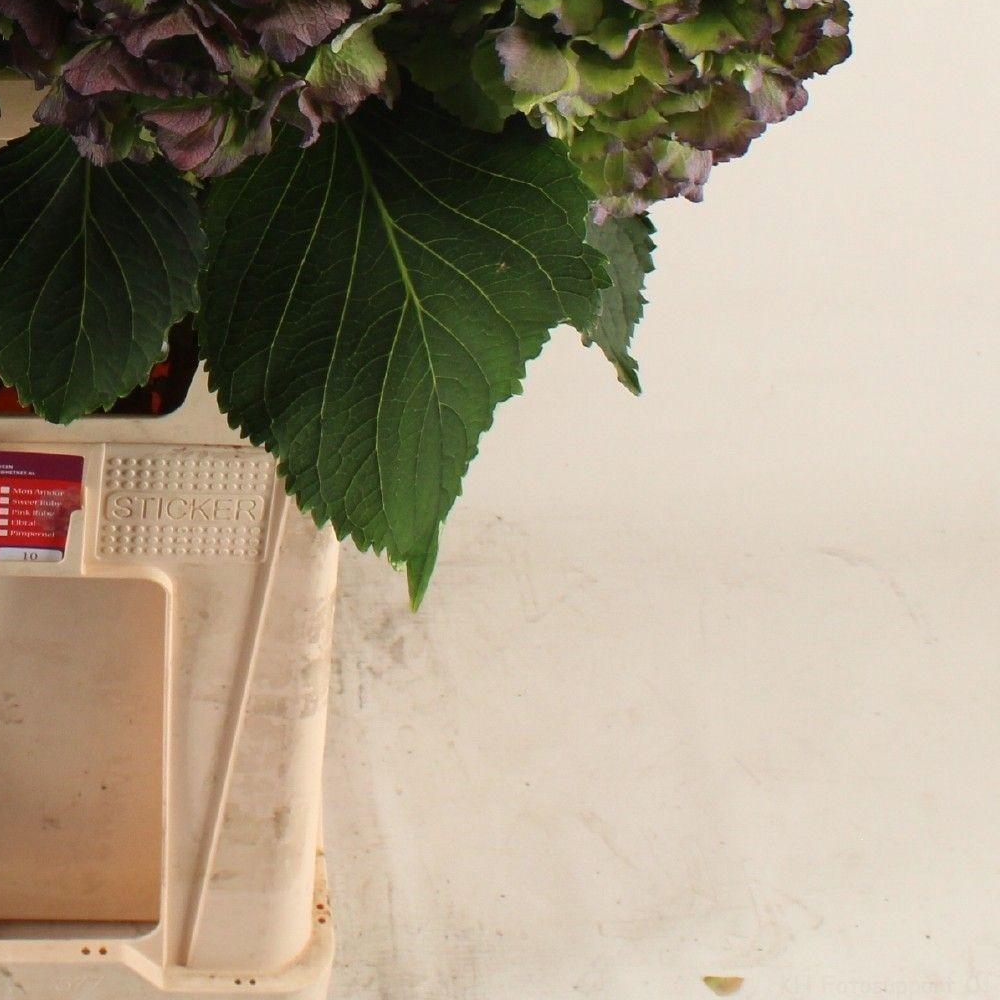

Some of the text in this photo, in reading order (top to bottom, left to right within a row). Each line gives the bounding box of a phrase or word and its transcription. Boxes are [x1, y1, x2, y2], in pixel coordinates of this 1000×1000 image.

[13, 487, 33, 496] Mon
[12, 498, 38, 506] Sweet
[11, 508, 31, 516] Pink
[112, 495, 257, 521] STICKER
[10, 529, 55, 538] Pimpernel
[24, 552, 38, 561] 10
